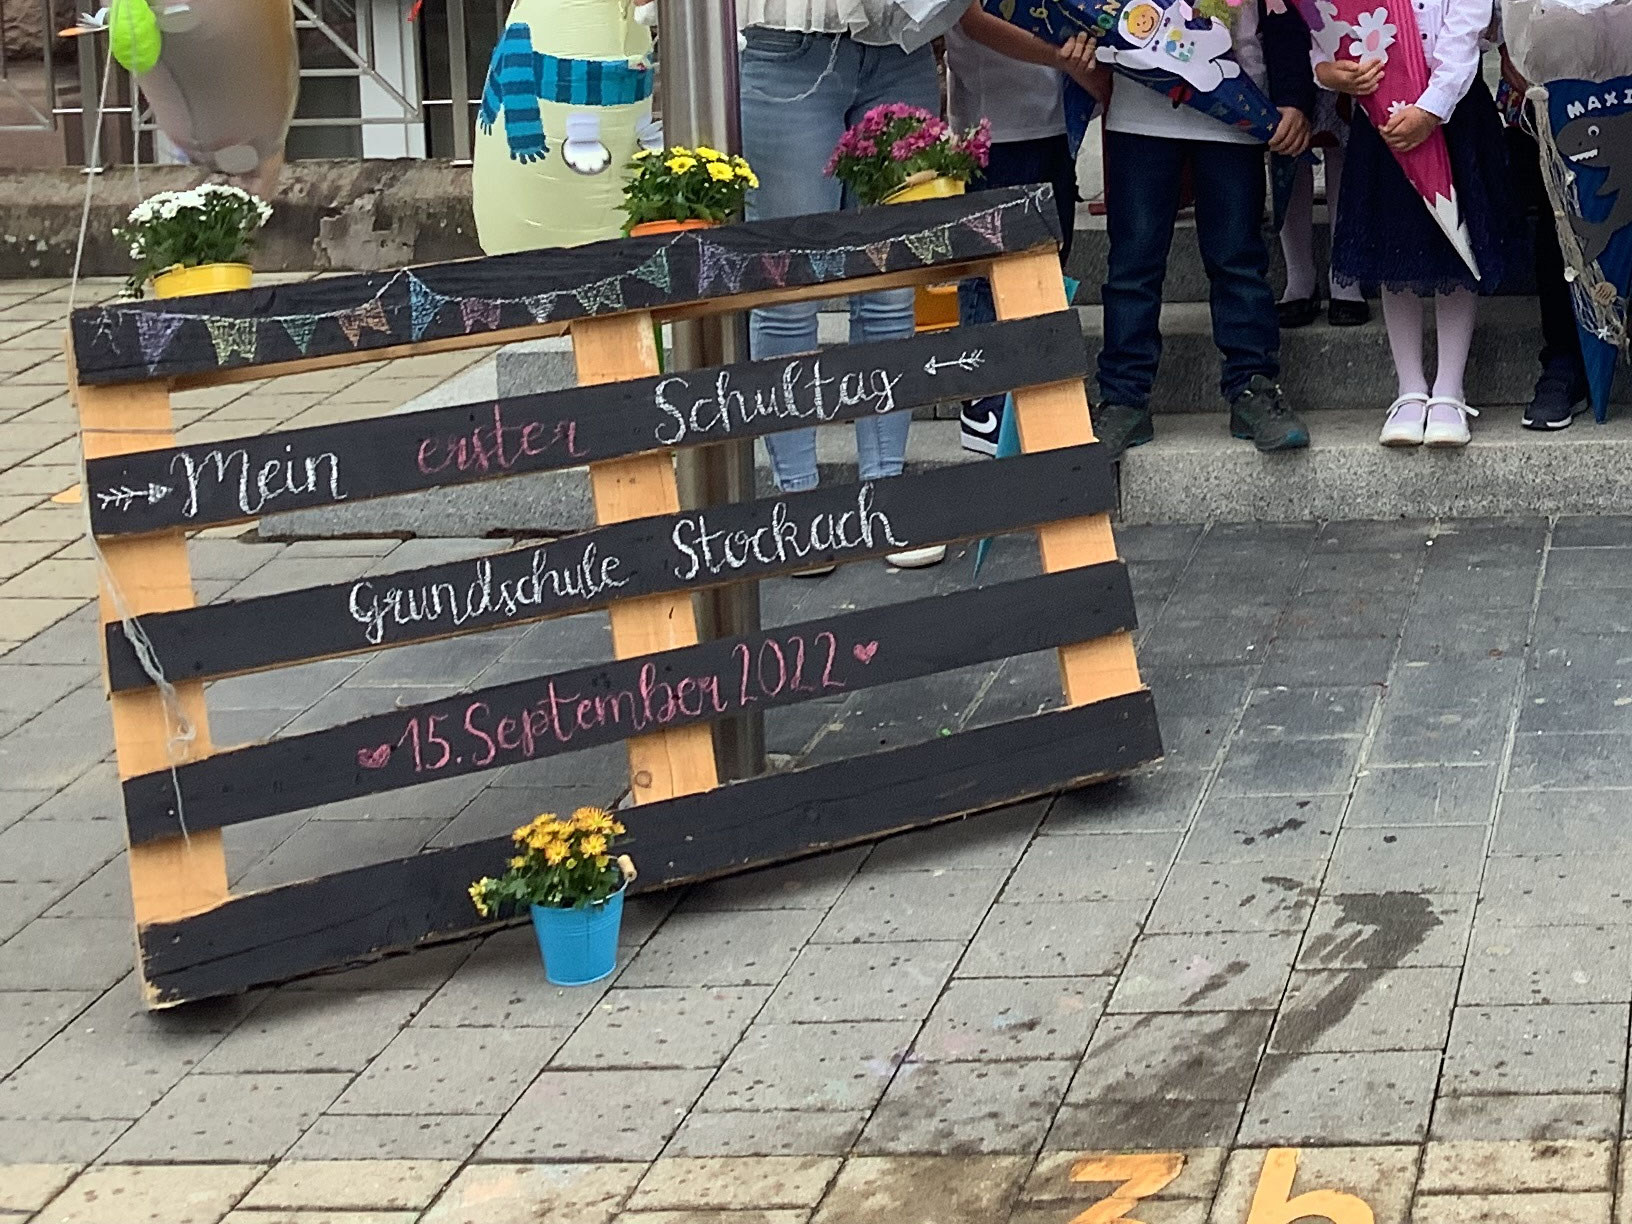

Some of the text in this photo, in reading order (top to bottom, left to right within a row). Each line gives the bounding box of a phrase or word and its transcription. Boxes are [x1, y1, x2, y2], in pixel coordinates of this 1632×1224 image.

[169, 359, 904, 518] Mein erster Schultag
[349, 481, 909, 645] Grundschule Stockach
[731, 630, 846, 706] 2022
